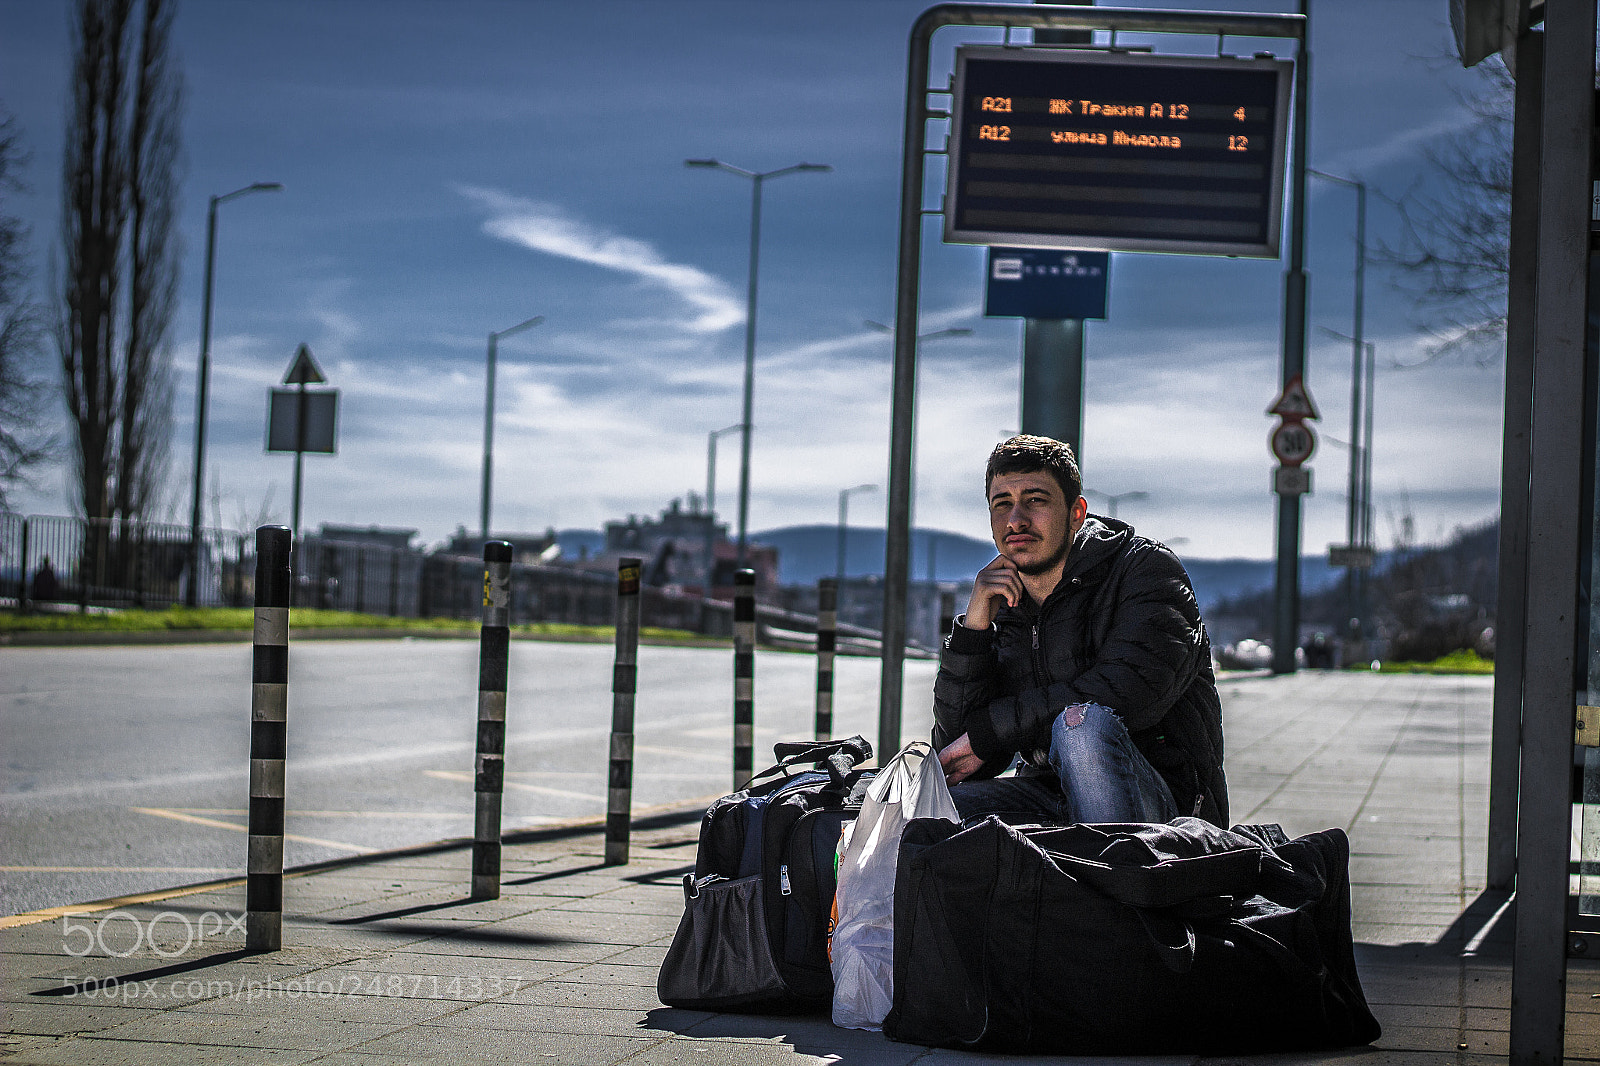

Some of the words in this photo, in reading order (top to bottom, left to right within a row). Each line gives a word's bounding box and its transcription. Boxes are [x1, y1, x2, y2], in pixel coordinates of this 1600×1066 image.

[1168, 103, 1190, 120] 12
[1233, 106, 1246, 122] 4
[1228, 134, 1249, 151] 12
